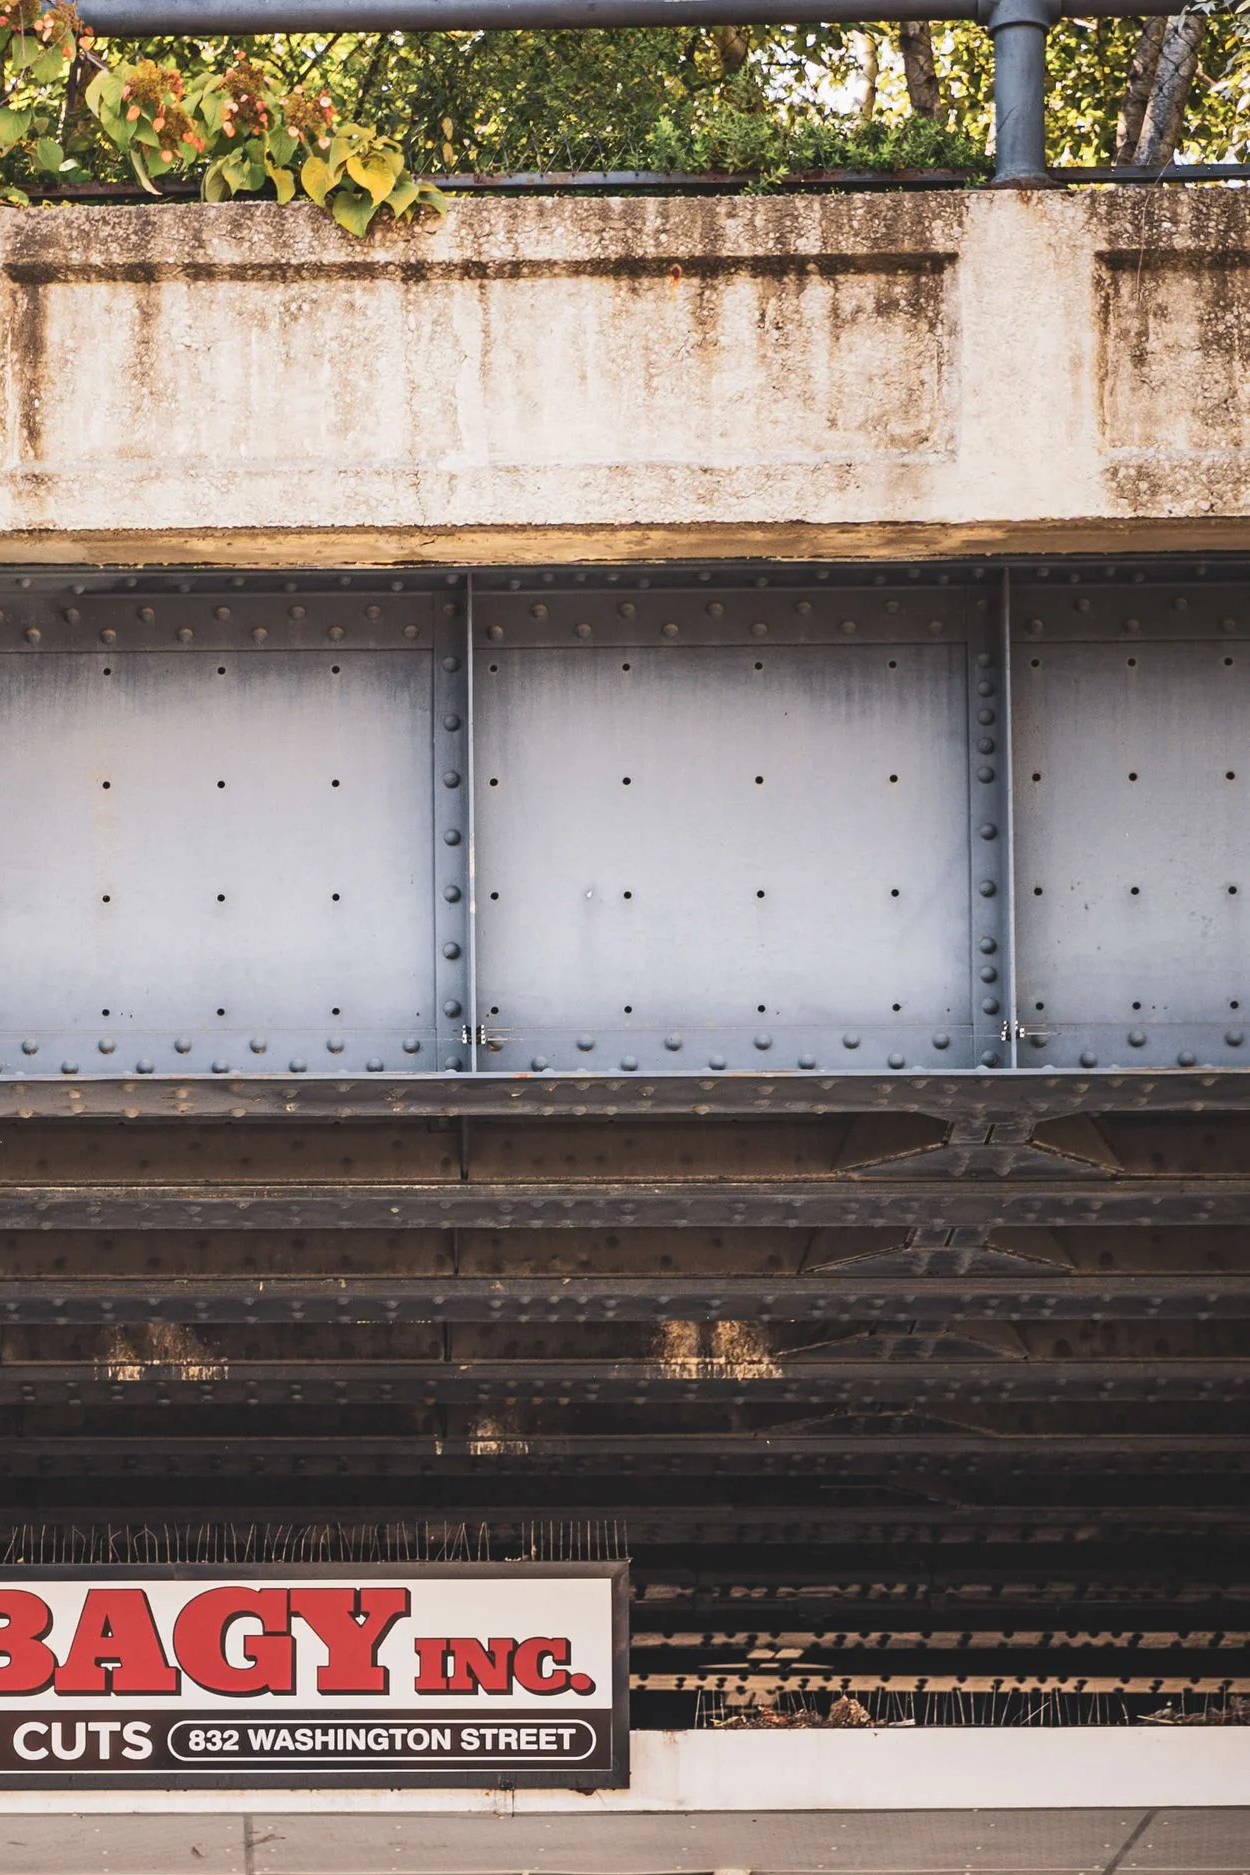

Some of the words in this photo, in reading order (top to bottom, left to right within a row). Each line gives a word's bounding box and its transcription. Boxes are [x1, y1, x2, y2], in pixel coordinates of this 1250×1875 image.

[414, 1636, 597, 1697] INC.
[12, 1721, 153, 1761] CUTS
[188, 1730, 240, 1752] 832
[247, 1729, 451, 1752] WASHINGTON
[460, 1728, 576, 1751] STREET
